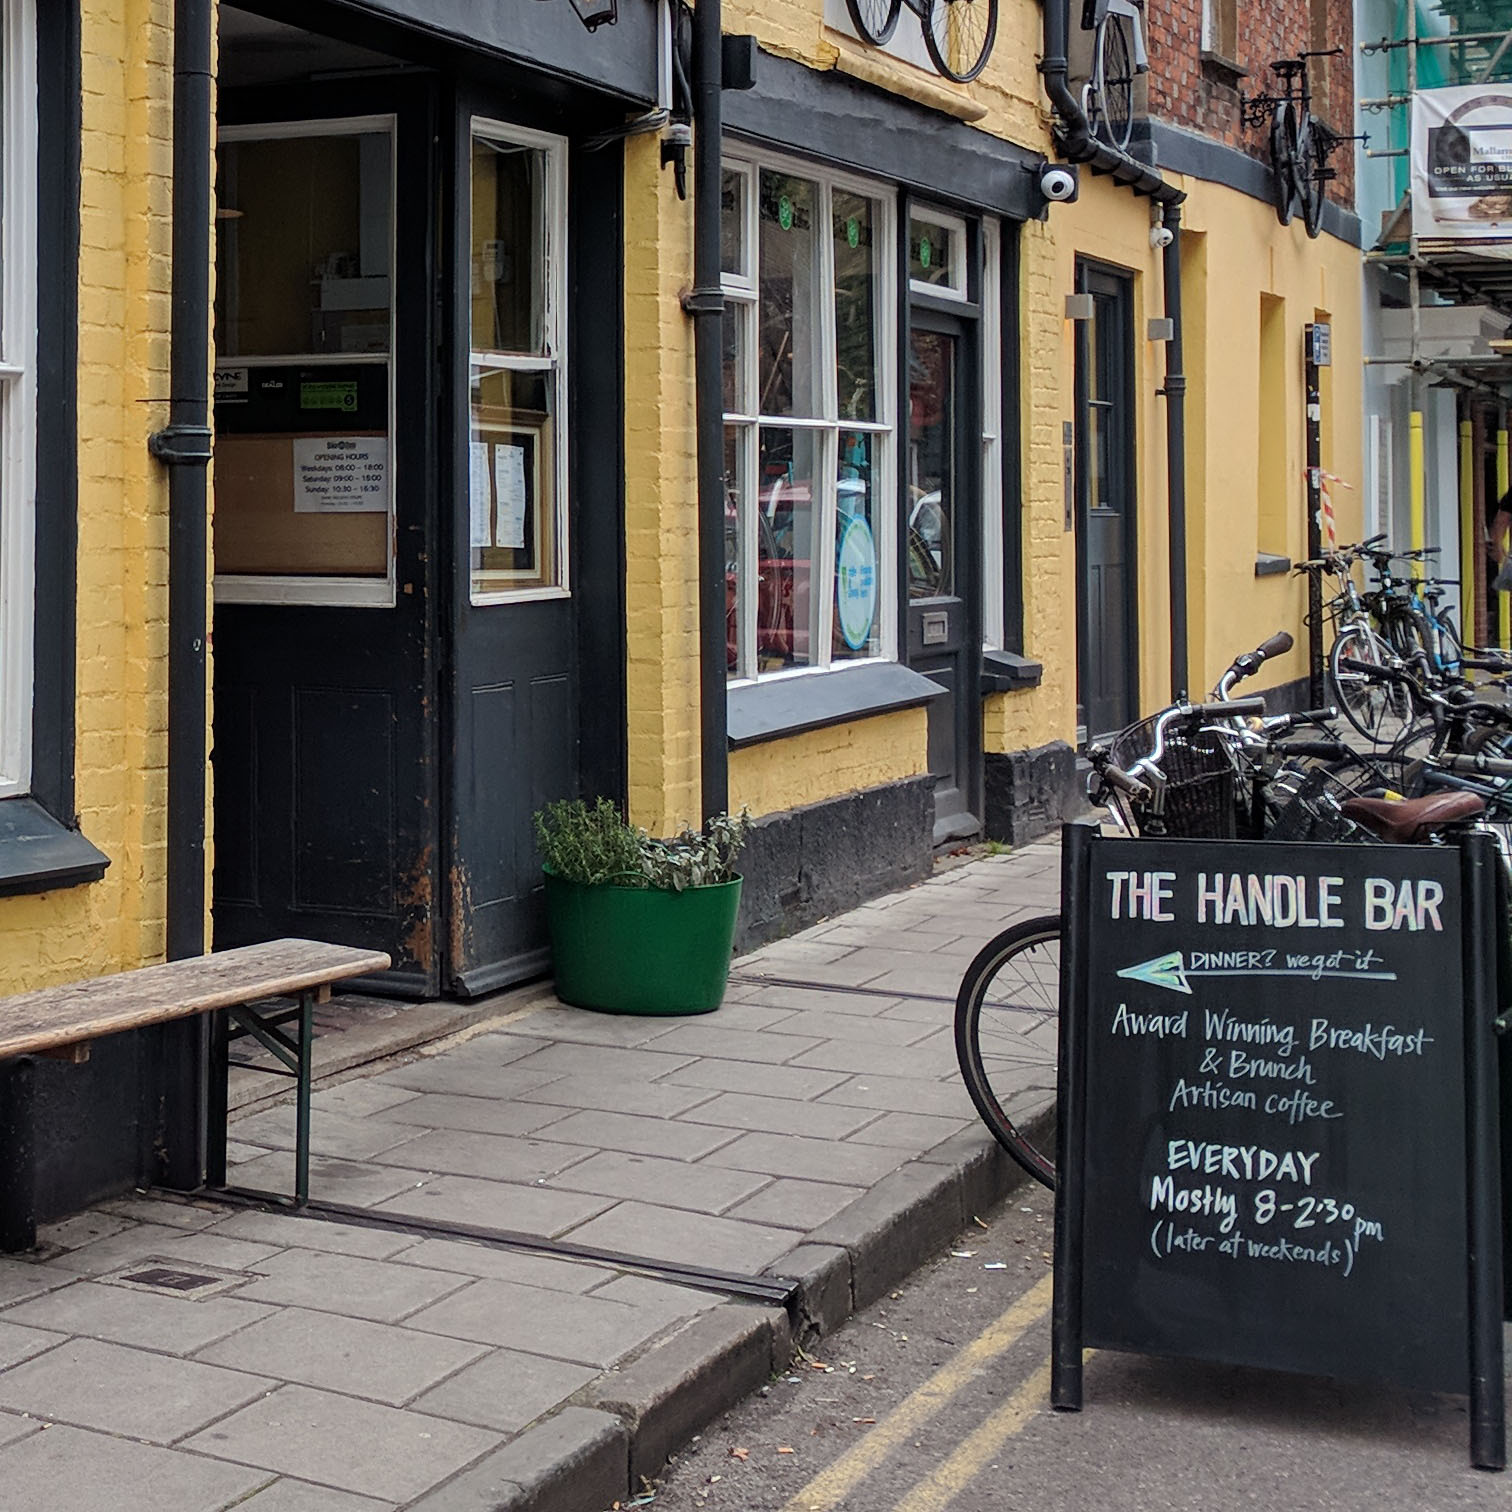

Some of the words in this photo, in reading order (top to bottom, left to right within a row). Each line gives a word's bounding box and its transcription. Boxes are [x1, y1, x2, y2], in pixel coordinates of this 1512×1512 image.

[1433, 166, 1466, 175] OPEN
[1470, 165, 1495, 173] FOR
[1106, 871, 1177, 922] THE
[1198, 873, 1344, 929] HANDLE
[1365, 878, 1445, 932] BAR
[1191, 949, 1277, 970] DINNER?
[1111, 1004, 1188, 1038] Award
[1205, 1008, 1300, 1057] Winning
[1309, 1018, 1435, 1061] Breakfast
[1199, 1047, 1223, 1075] &
[1229, 1050, 1317, 1085] Brunch
[1169, 1079, 1257, 1112] Artisan
[1264, 1091, 1344, 1125] coffee
[1168, 1140, 1320, 1186] EVERYDAY
[1150, 1175, 1238, 1234] Mostly
[1151, 1220, 1215, 1258] (later
[1218, 1231, 1245, 1258] at
[1247, 1238, 1354, 1277] weekends)
